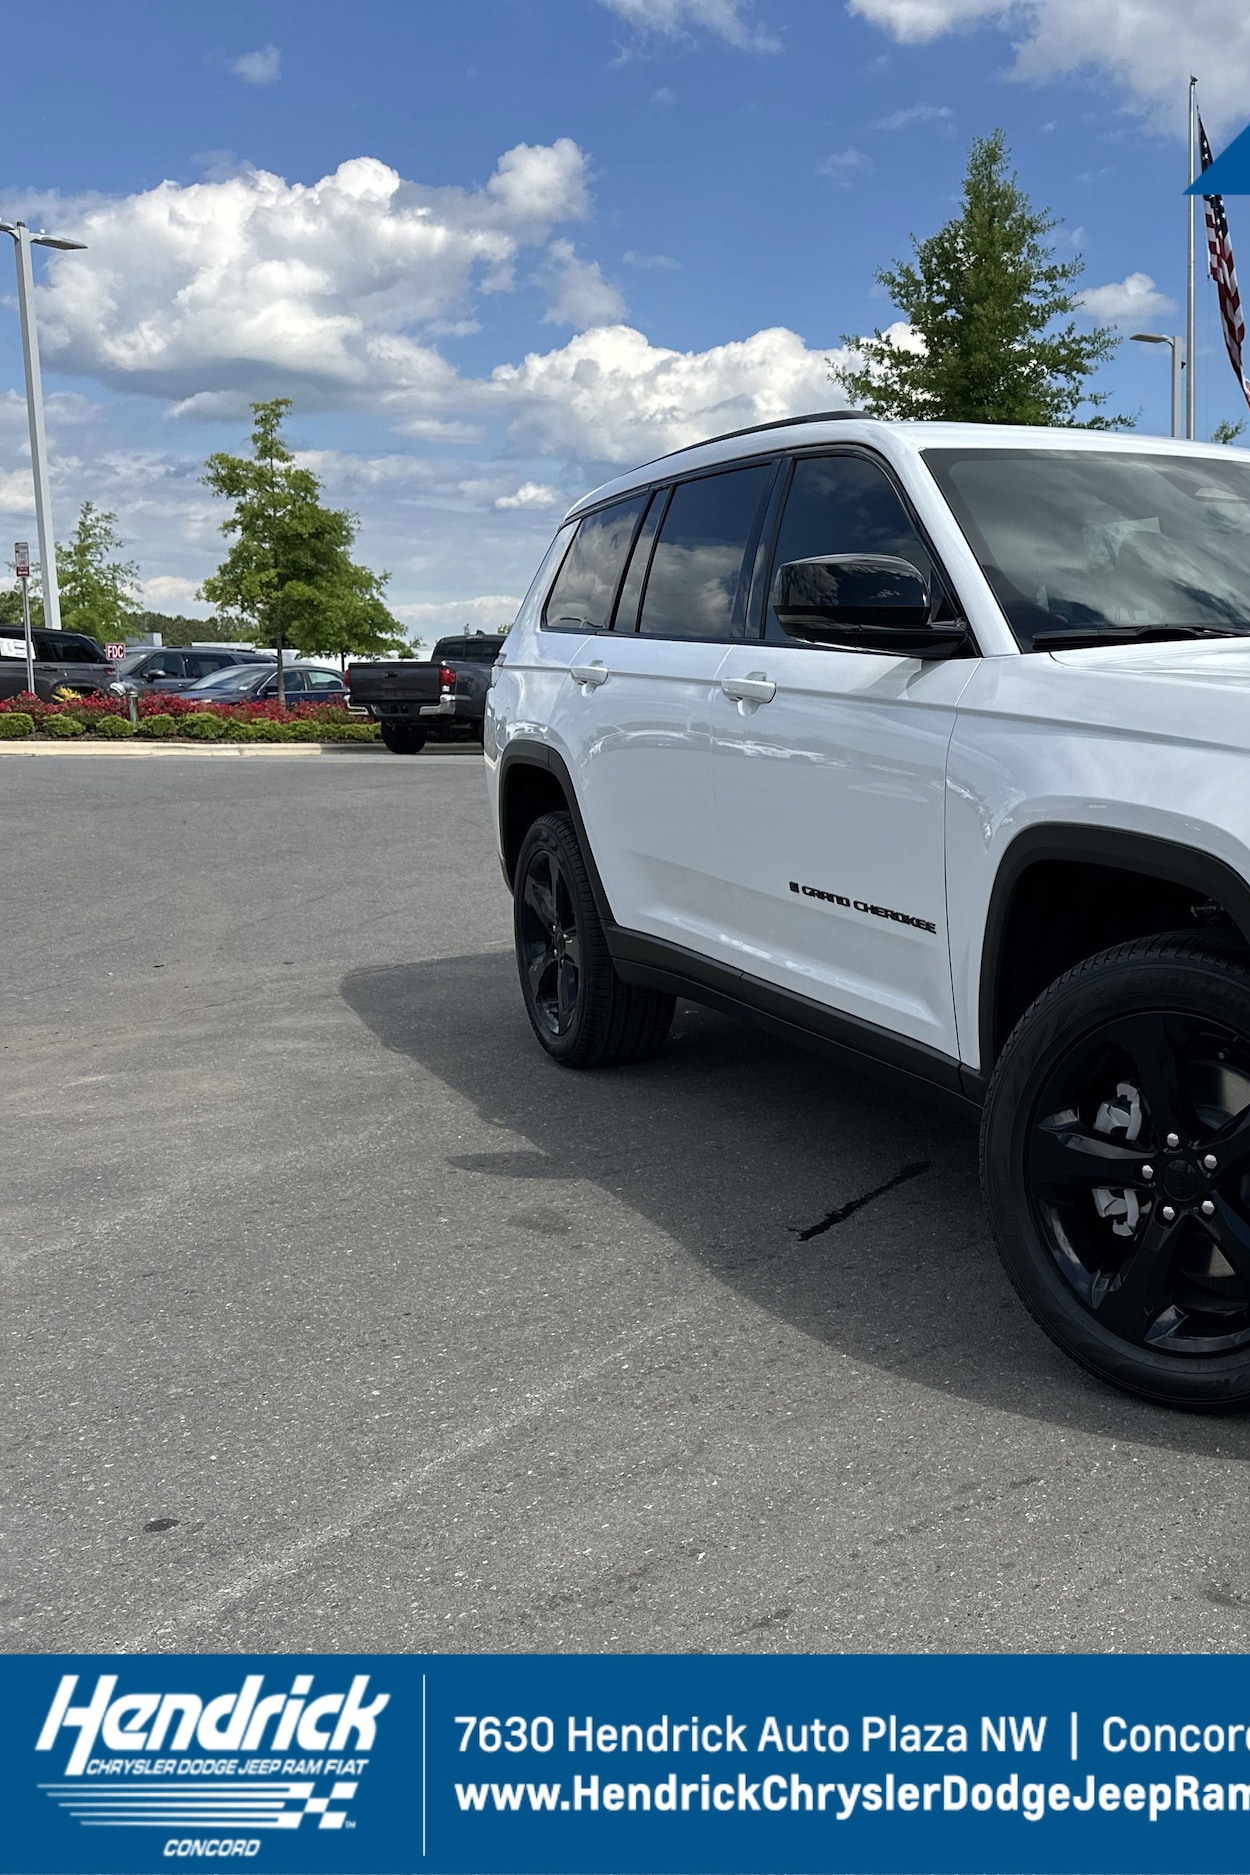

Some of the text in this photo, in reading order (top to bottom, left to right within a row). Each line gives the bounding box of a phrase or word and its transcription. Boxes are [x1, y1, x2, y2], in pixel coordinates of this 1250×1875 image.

[107, 645, 124, 658] FDC
[801, 885, 937, 934] GRAND CHEROKEE
